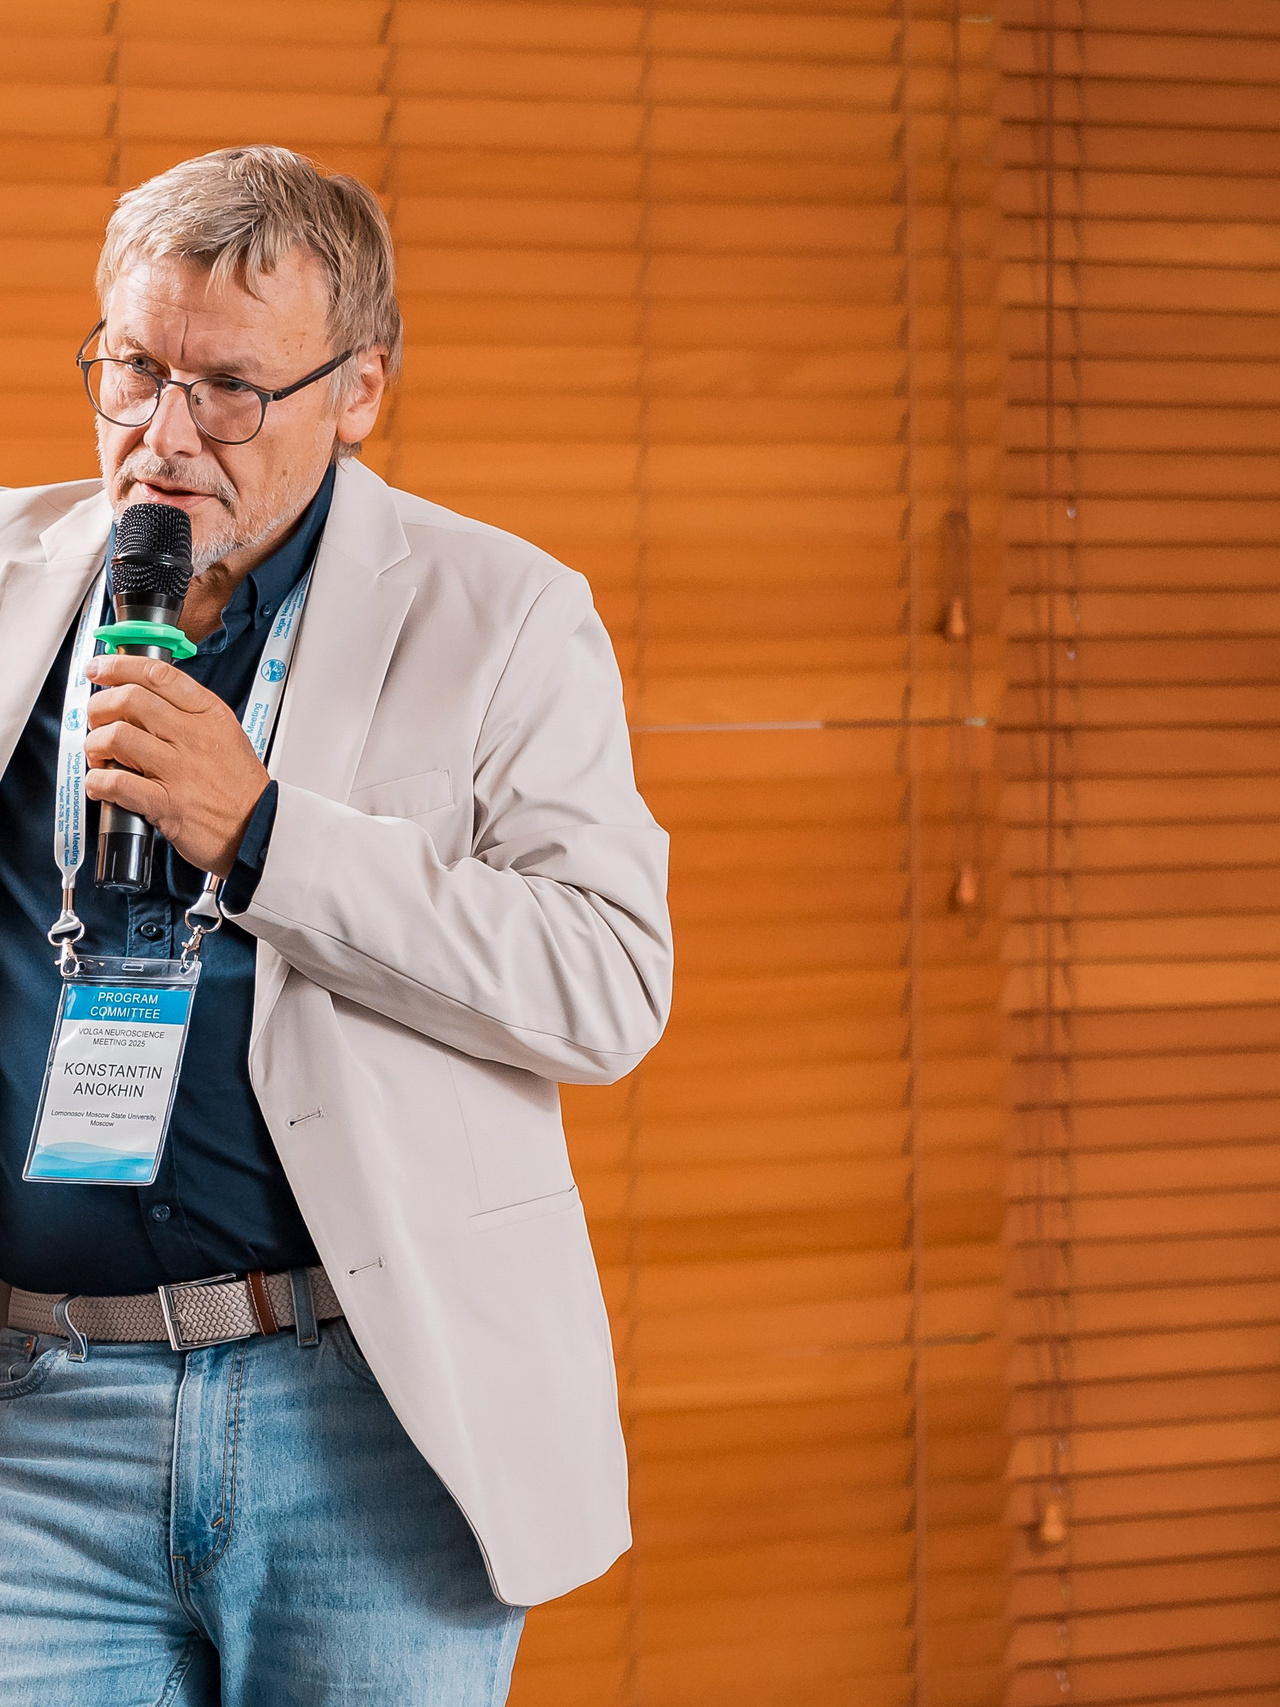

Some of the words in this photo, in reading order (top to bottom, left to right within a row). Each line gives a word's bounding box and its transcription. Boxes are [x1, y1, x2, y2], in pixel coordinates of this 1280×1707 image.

[274, 618, 286, 638] Volga
[246, 703, 263, 733] Meeting
[72, 752, 82, 774] Volga
[73, 776, 81, 831] Neuroscience
[69, 832, 80, 866] Meeting
[98, 991, 159, 1004] PROGRAM
[90, 1005, 161, 1019] COMMITTEE
[78, 1027, 103, 1036] VOLGA
[104, 1028, 165, 1039] NEUROSCIENCE
[92, 1038, 127, 1047] MEETING
[128, 1039, 146, 1048] 2025
[64, 1062, 163, 1080] KONSTANTIN
[73, 1082, 145, 1098] ANOKHIN
[50, 1109, 85, 1117] Lomonosov
[85, 1110, 110, 1119] Moscow
[110, 1112, 126, 1120] State
[89, 1119, 115, 1127] Moscow
